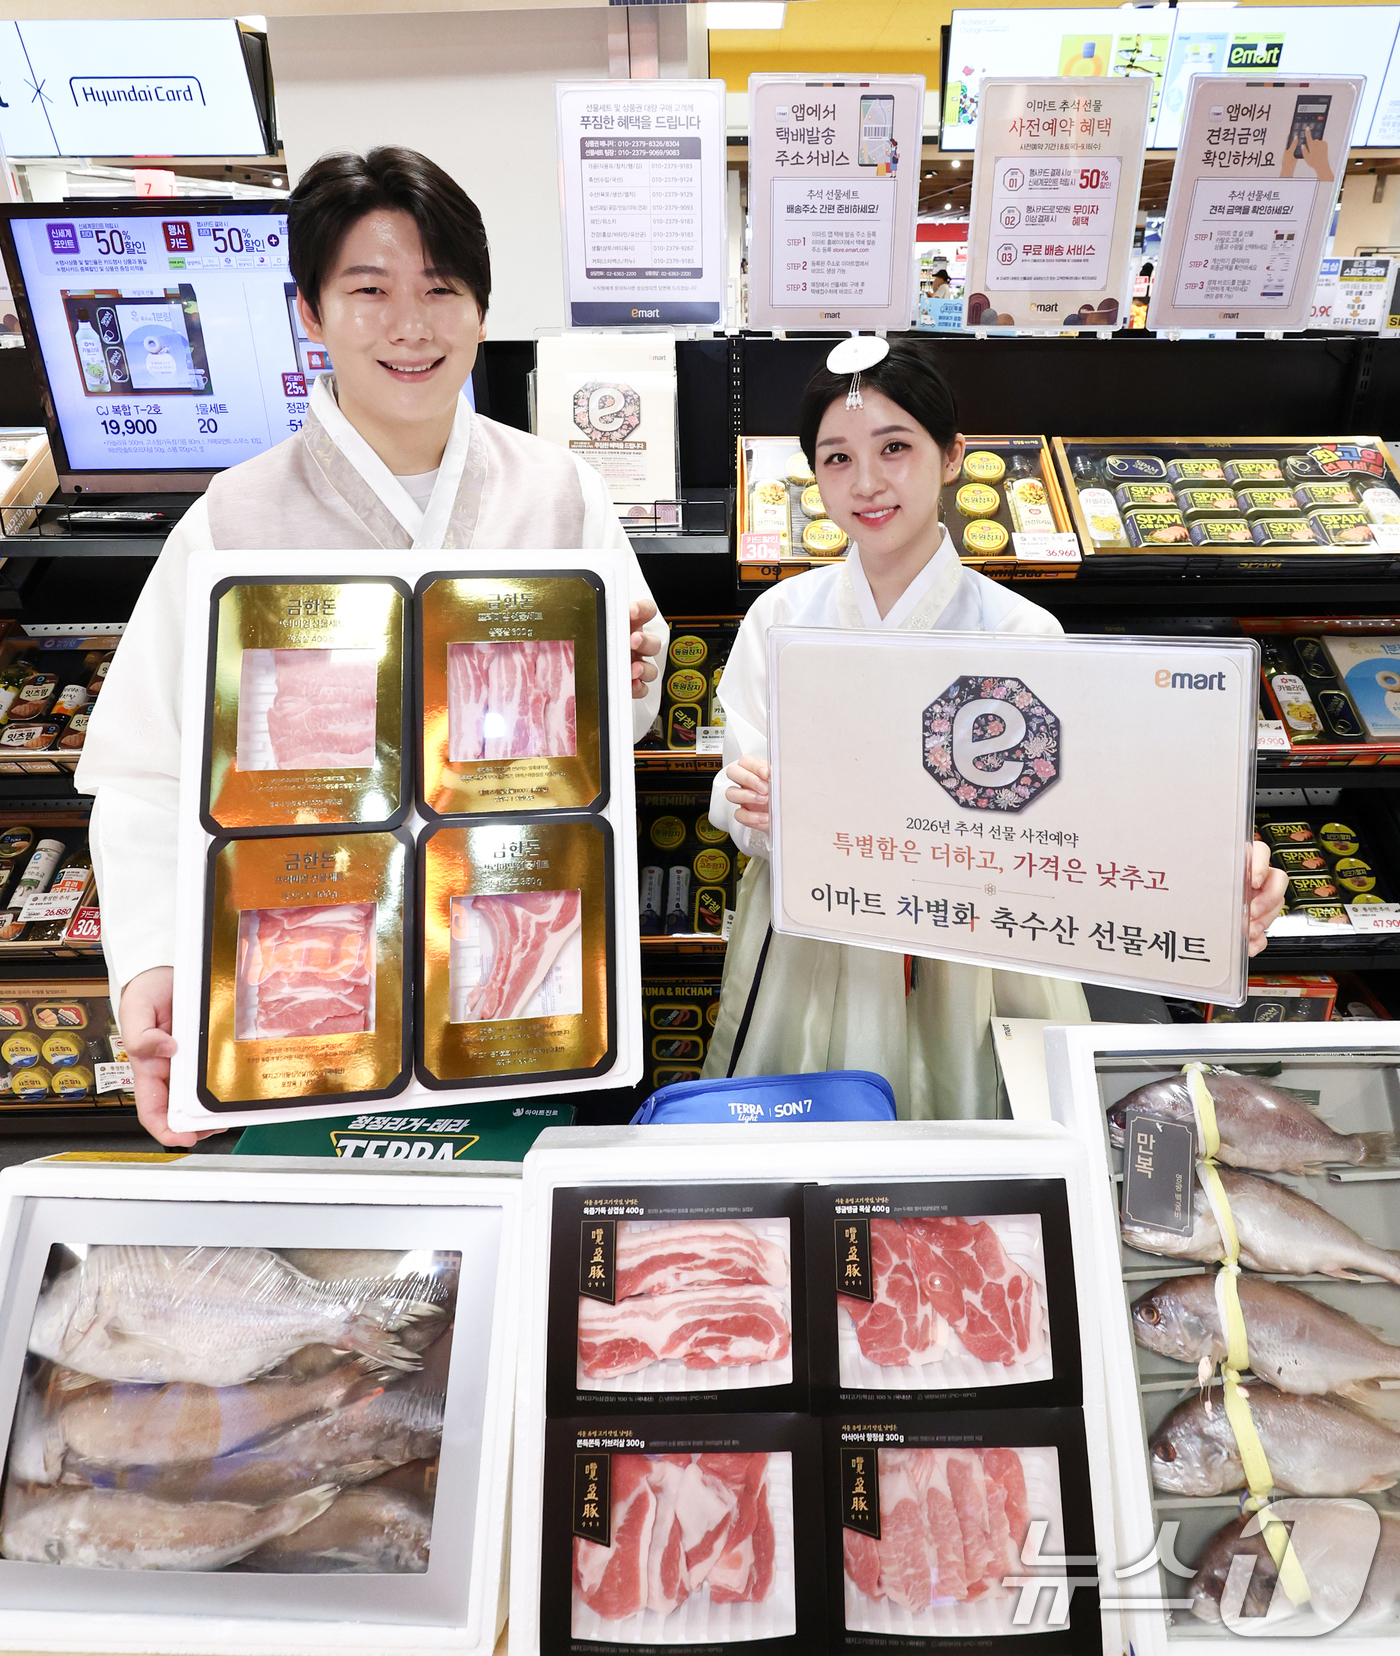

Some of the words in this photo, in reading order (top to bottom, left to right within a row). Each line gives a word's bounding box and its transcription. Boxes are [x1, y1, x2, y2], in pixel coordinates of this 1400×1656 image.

[586, 103, 612, 113] 선물세트
[614, 103, 621, 113] 및
[791, 103, 836, 121] 앱에서
[1026, 100, 1057, 112] 이마트
[1059, 100, 1080, 112] 추석
[1082, 100, 1103, 113] 선물
[1226, 103, 1272, 121] 앱에서
[580, 115, 615, 130] 푸짐한
[617, 115, 652, 130] 혜택을
[655, 115, 701, 130] 드립니다
[1008, 117, 1075, 137] 사전예약
[1080, 117, 1112, 137] 혜택
[775, 126, 836, 145] 택배발송
[1206, 126, 1268, 146] 견적금액
[775, 150, 850, 167] 주소서비스
[1201, 149, 1276, 168] 확인하세요
[143, 183, 152, 195] 7
[806, 189, 823, 200] 추석
[825, 189, 860, 200] 선물세트
[1228, 190, 1246, 201] 추석
[1246, 190, 1281, 201] 선물세트
[786, 204, 818, 214] 배송주소
[819, 204, 835, 214] 간편
[836, 204, 879, 214] 준비하세요!
[1073, 205, 1100, 215] 무이자
[1209, 205, 1226, 215] 견적
[1226, 205, 1250, 215] 금액을
[1251, 205, 1294, 215] 확인하세요!
[1004, 216, 1016, 226] 02
[1072, 216, 1090, 226] 혜택
[167, 224, 186, 236] 행사
[53, 239, 75, 250] 포인트
[125, 241, 147, 255] 할인
[170, 237, 189, 249] 카드
[244, 239, 266, 253] 할인
[786, 238, 802, 246] STEP
[1022, 244, 1043, 256] 무료
[1044, 244, 1065, 256] 배송
[1066, 244, 1096, 256] 서비스
[1001, 253, 1012, 263] 03
[786, 263, 802, 271] STEP
[802, 261, 808, 271] 2
[785, 284, 801, 292] STEP
[801, 282, 807, 292] 3
[631, 308, 660, 318] emart
[1030, 303, 1059, 313] emart
[819, 311, 841, 319] emart
[1218, 311, 1240, 319] emart
[286, 382, 305, 395] 25%
[96, 406, 109, 416] CJ
[111, 404, 132, 417] 복합
[133, 404, 162, 415] T-2호
[195, 403, 229, 416] 물세트
[101, 419, 158, 436] 19,900
[1182, 462, 1220, 474] SPAM
[1238, 462, 1278, 474] SPAM
[1130, 485, 1169, 497] SPAM
[1193, 491, 1231, 503] SPAM
[1253, 491, 1291, 503] SPAM
[1311, 485, 1349, 497] SPAM
[1136, 513, 1181, 525] SPAM
[1318, 513, 1367, 525] SPAM
[1206, 522, 1245, 534] SPAM
[1269, 522, 1308, 534] SPAM
[746, 535, 778, 544] 카드할인
[746, 544, 778, 559] 30%
[487, 592, 535, 610] 금한돈
[286, 599, 337, 616] 금한돈
[1154, 668, 1227, 692] emart
[951, 697, 1028, 788] e
[644, 796, 696, 806] PREMIUM
[905, 816, 952, 836] 2026년
[953, 820, 984, 840] 추석
[987, 823, 1017, 843] 선물
[1019, 827, 1080, 850] 사전예약
[1270, 825, 1304, 834] SPAM
[284, 850, 336, 871] 금한돈
[831, 830, 923, 865] 특별함은
[930, 842, 1005, 876] 더하고,
[1012, 850, 1089, 886] 가격은
[1095, 861, 1171, 893] 낮추고
[1282, 851, 1317, 861] SPAM
[1293, 879, 1329, 889] SPAM
[1307, 907, 1343, 918] SPAM
[73, 919, 101, 936] 30%
[810, 882, 887, 917] 이마트
[895, 894, 981, 934] 차별화
[988, 906, 1080, 947] 축수산
[1086, 923, 1213, 965] 선물세트
[666, 986, 674, 996] &
[675, 986, 713, 997] RICHAM
[1004, 1023, 1013, 1041] emart
[524, 1108, 559, 1117] 하이트진로
[728, 1102, 765, 1117] TERRA
[737, 1112, 759, 1123] Light
[347, 1115, 471, 1133] 청정라거-테라
[1135, 1132, 1156, 1179] 만복
[607, 1206, 625, 1215] 삼겹살
[859, 1205, 871, 1214] 목살
[601, 1439, 626, 1448] 가브리살
[866, 1433, 884, 1442] 항정살
